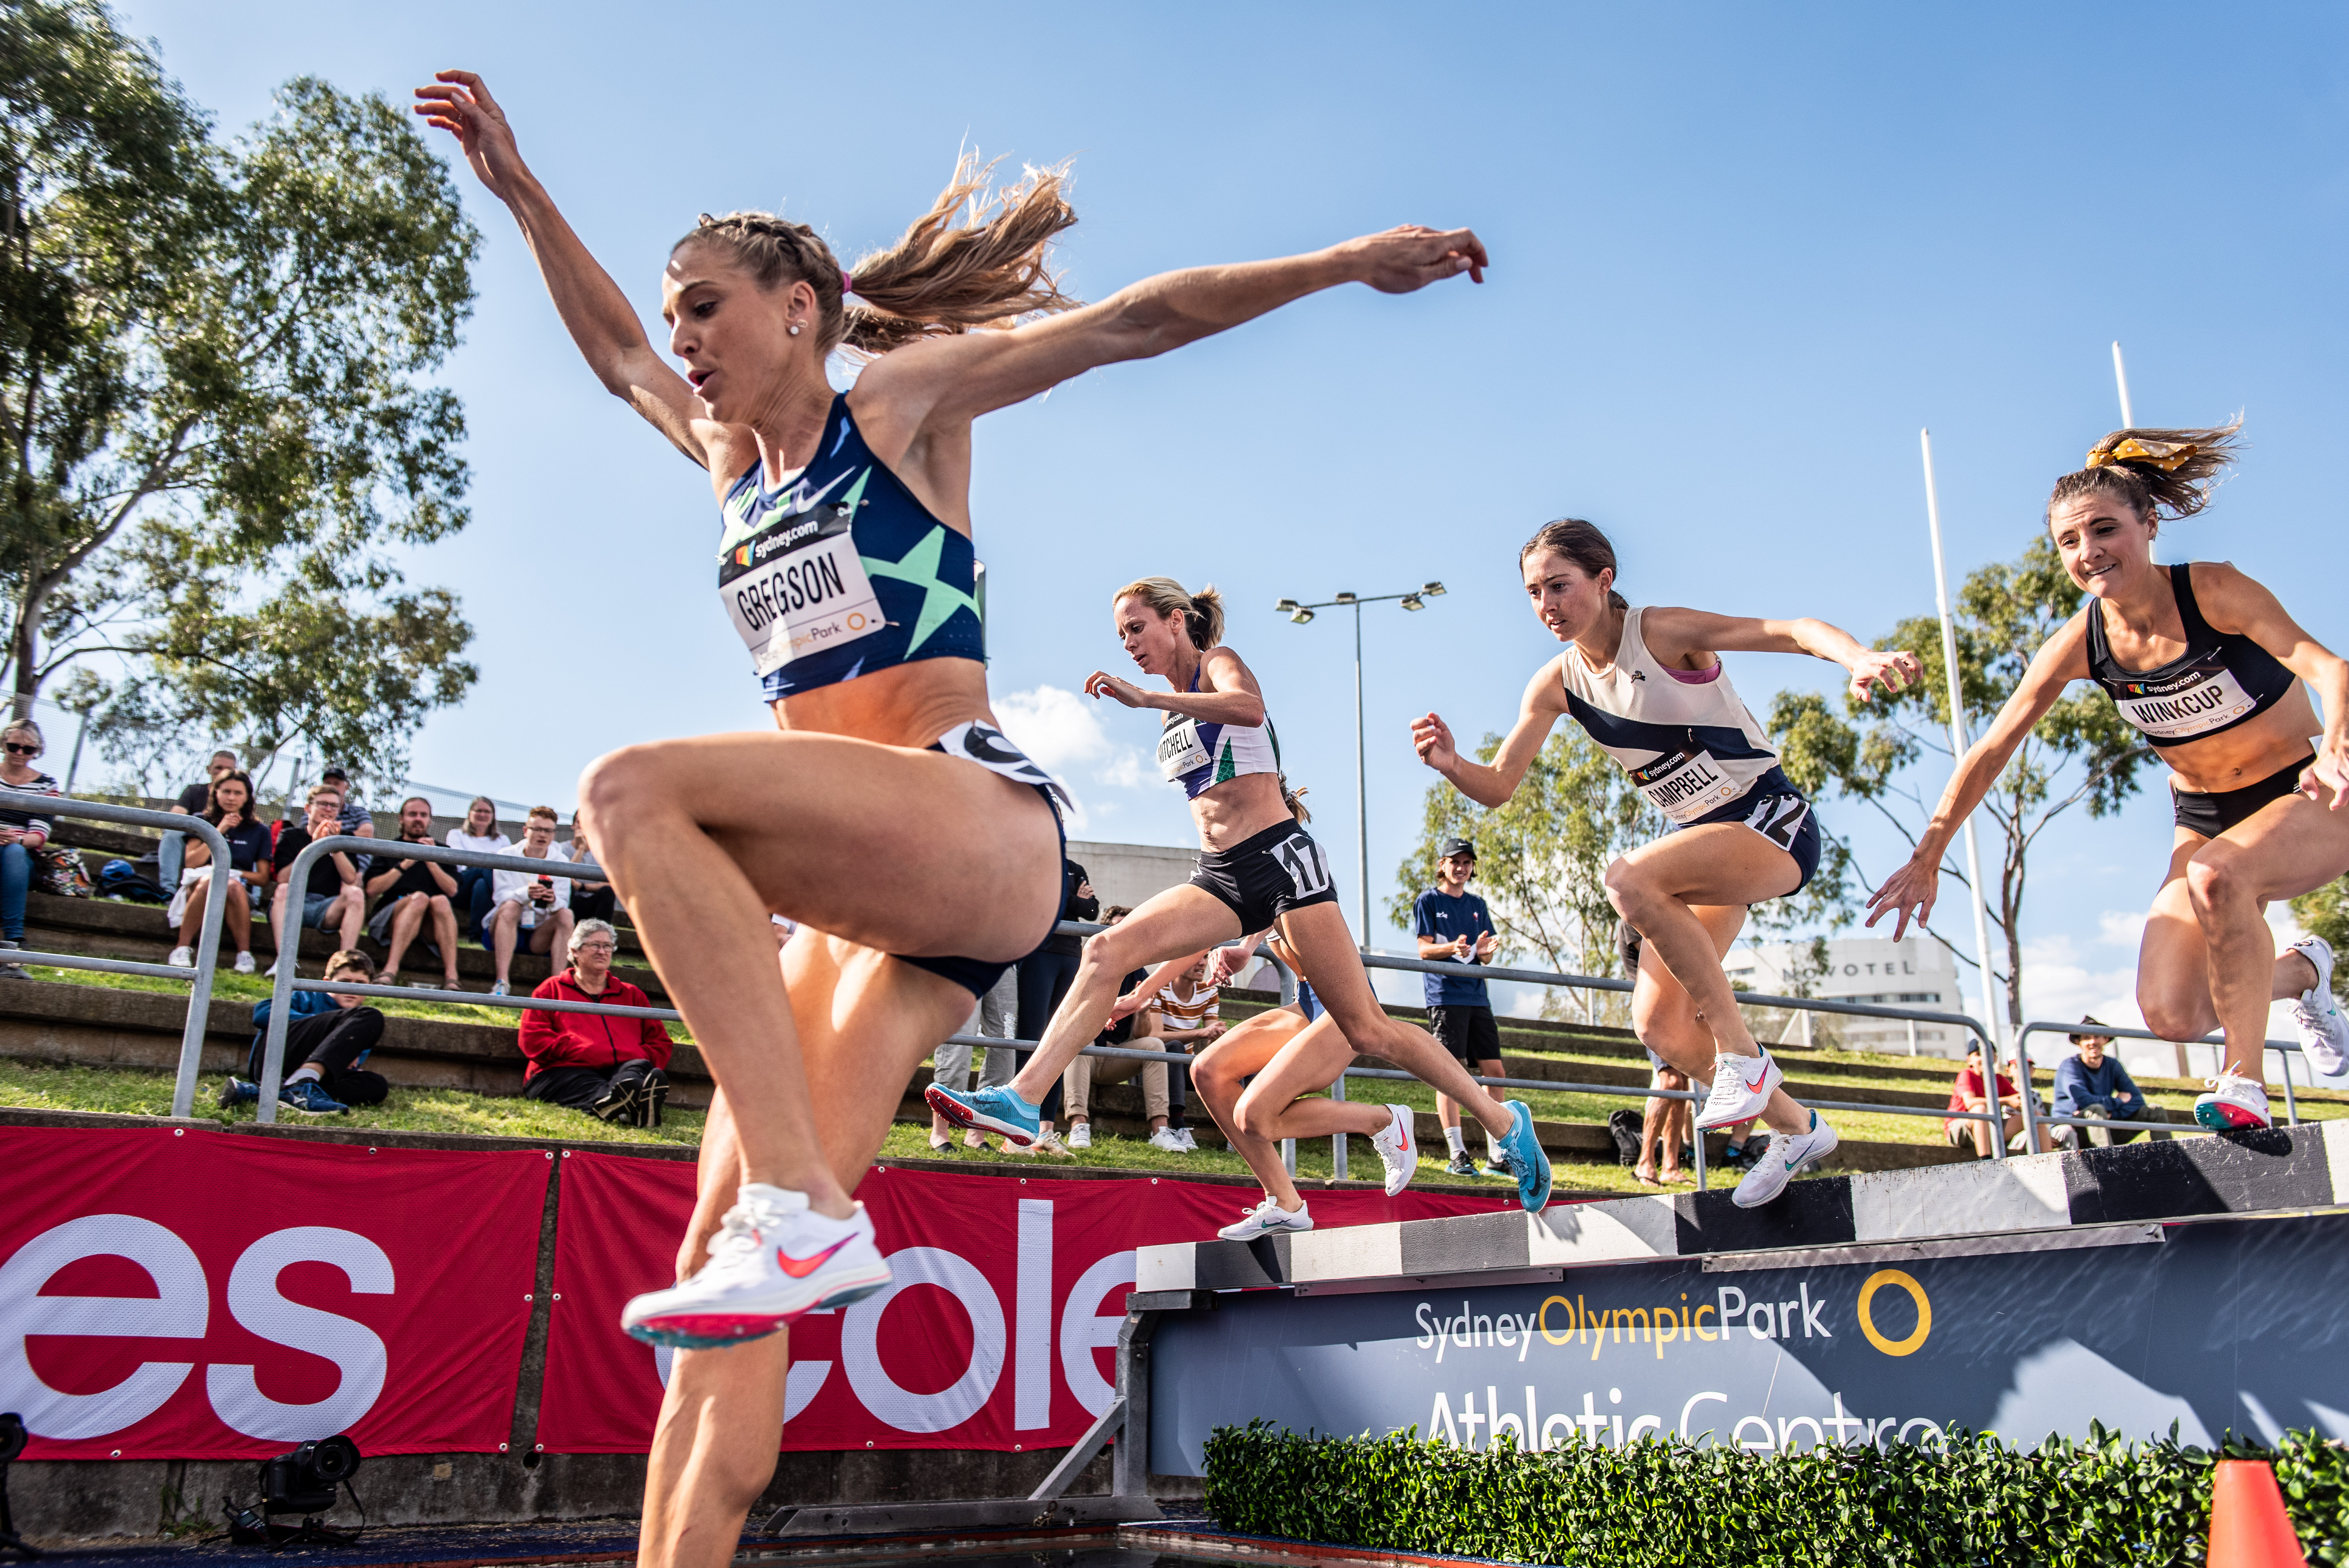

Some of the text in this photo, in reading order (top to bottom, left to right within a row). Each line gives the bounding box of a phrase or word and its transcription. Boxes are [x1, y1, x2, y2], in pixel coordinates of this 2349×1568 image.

[755, 520, 818, 558] sydney.com
[736, 552, 845, 631] GREGSON
[2147, 672, 2201, 693] sydney.com
[2131, 685, 2223, 724] WINKCUP
[1158, 729, 1193, 764] MITCHELL
[1649, 752, 1685, 777] sydney.com
[1647, 763, 1719, 808] CAMPBELL
[1672, 795, 1720, 821] SydneyOlympicPark
[1754, 796, 1806, 848] 12
[1282, 836, 1326, 892] 17
[1416, 1282, 1832, 1363] SydneyOlympicPark
